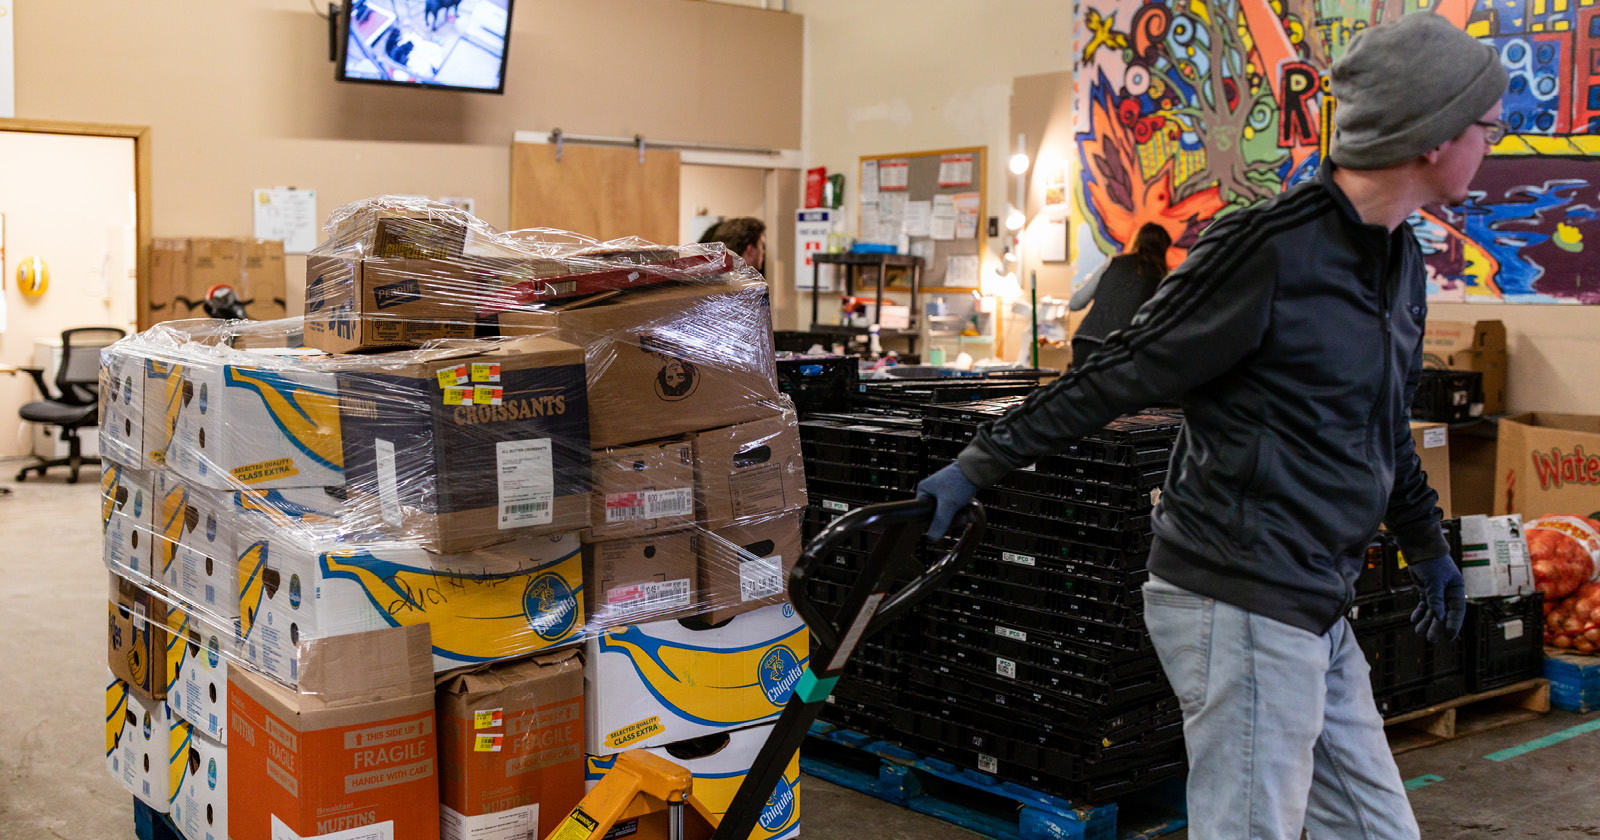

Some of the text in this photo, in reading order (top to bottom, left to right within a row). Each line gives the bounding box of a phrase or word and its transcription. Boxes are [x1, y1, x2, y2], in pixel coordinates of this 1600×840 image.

[454, 395, 566, 426] CROISSANTS
[234, 458, 289, 474] SELECTED QUALITY
[238, 465, 290, 481] CLASS EXTRA
[767, 666, 803, 703] Chiquita
[366, 725, 416, 742] THIS SIDE UP
[513, 725, 573, 754] FRAGILE
[610, 716, 657, 739] SELECTED QUALITY
[614, 723, 658, 746] CLASS EXTRA
[268, 739, 295, 772] FRAGILE
[353, 740, 425, 770] FRAGILE
[351, 764, 429, 788] HANDLE WITH CARE
[316, 802, 354, 815] Breakfast
[759, 788, 794, 829] Chiquita
[316, 810, 376, 836] MUFFINS
